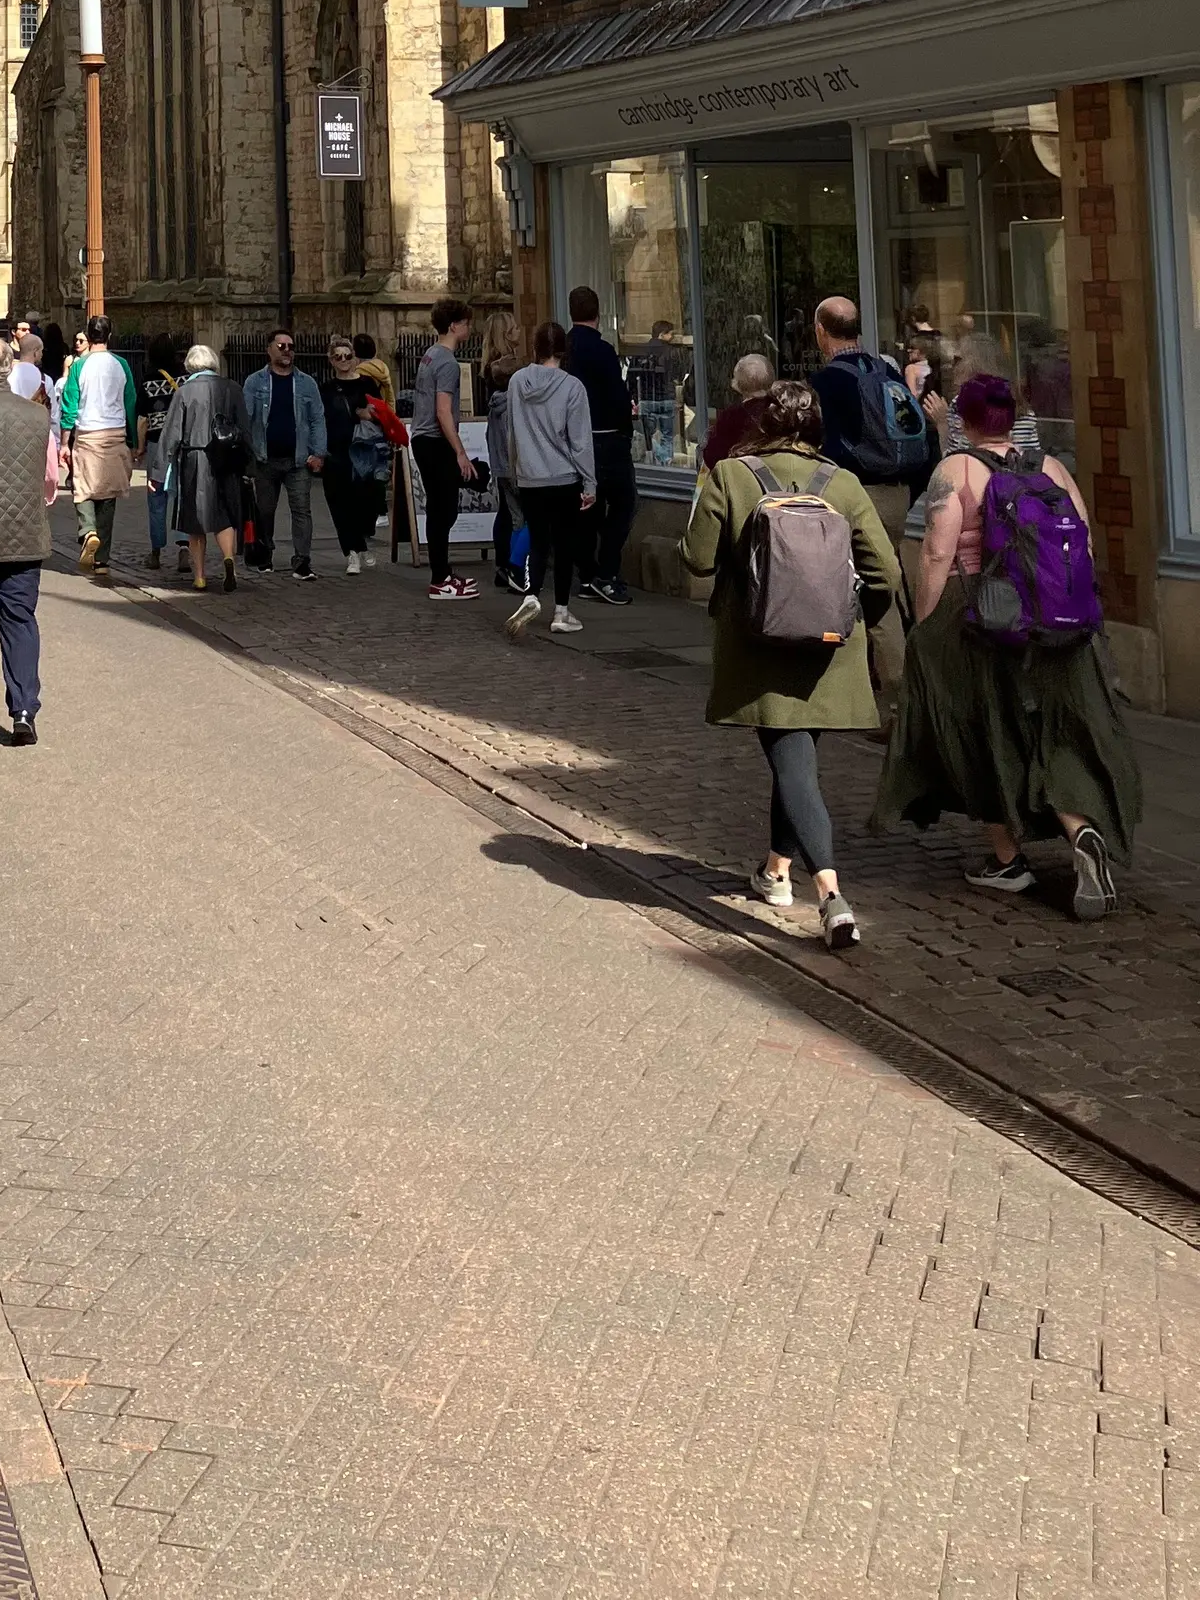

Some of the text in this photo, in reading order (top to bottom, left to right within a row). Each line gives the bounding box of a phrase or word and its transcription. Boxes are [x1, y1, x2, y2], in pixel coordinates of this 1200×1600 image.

[617, 63, 860, 126] cambridge contemporary art
[324, 122, 355, 132] MICHAEL
[328, 131, 351, 141] HOUSE
